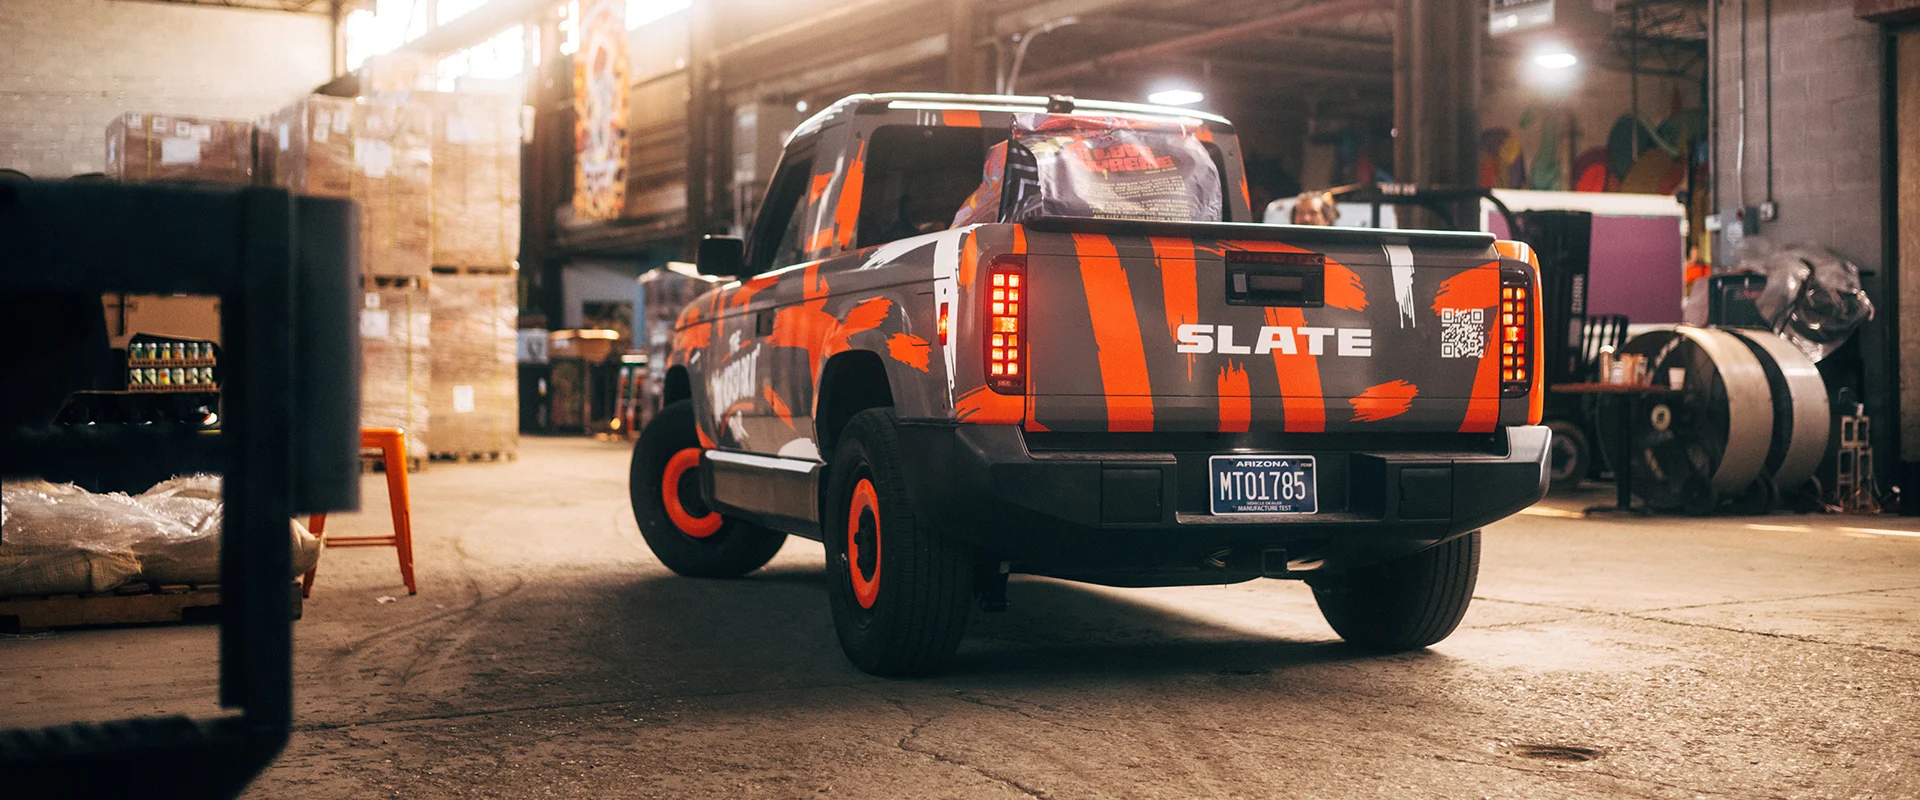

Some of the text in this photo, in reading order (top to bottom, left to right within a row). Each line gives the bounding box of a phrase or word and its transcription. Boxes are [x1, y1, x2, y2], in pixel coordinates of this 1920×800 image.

[1080, 156, 1175, 172] PREME
[1177, 324, 1372, 357] SLATE
[1220, 471, 1306, 500] MT01785
